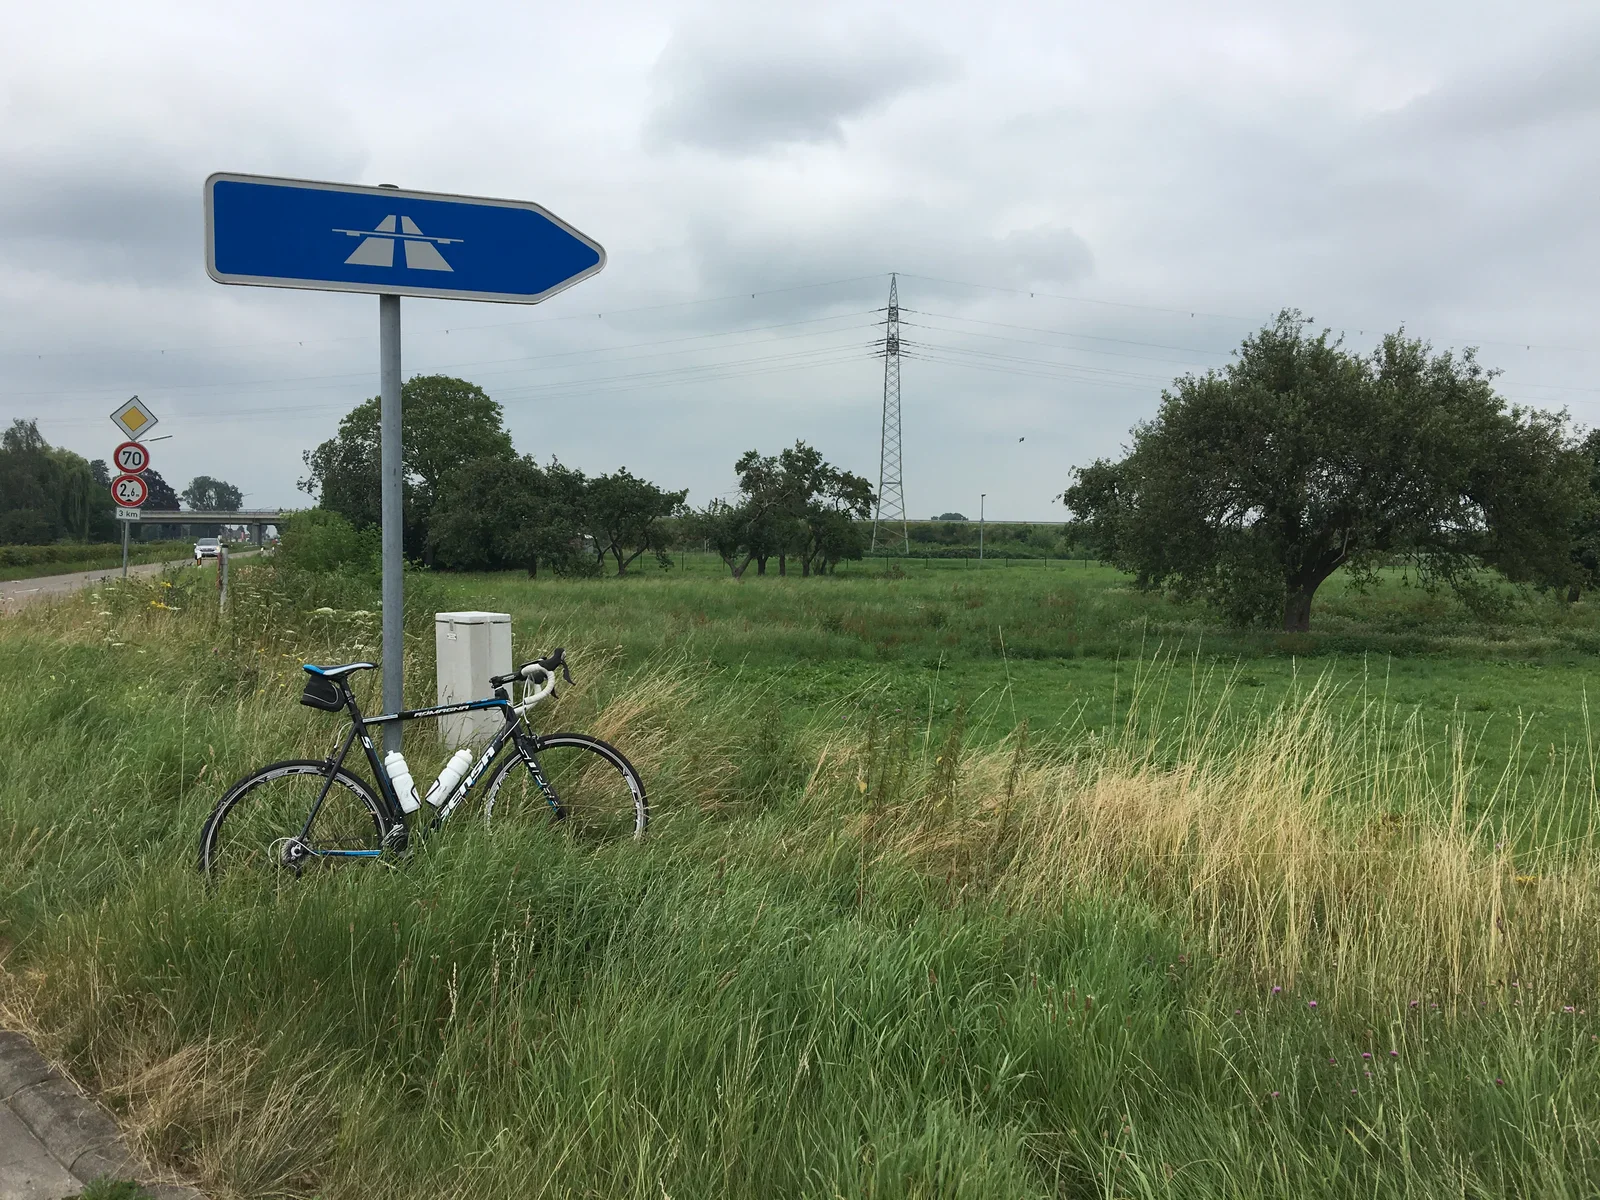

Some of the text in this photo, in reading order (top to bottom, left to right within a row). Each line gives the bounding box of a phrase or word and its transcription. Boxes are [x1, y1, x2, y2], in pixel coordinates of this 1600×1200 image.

[122, 450, 142, 466] 70
[125, 510, 138, 518] km
[413, 704, 470, 718] ROMAGNA
